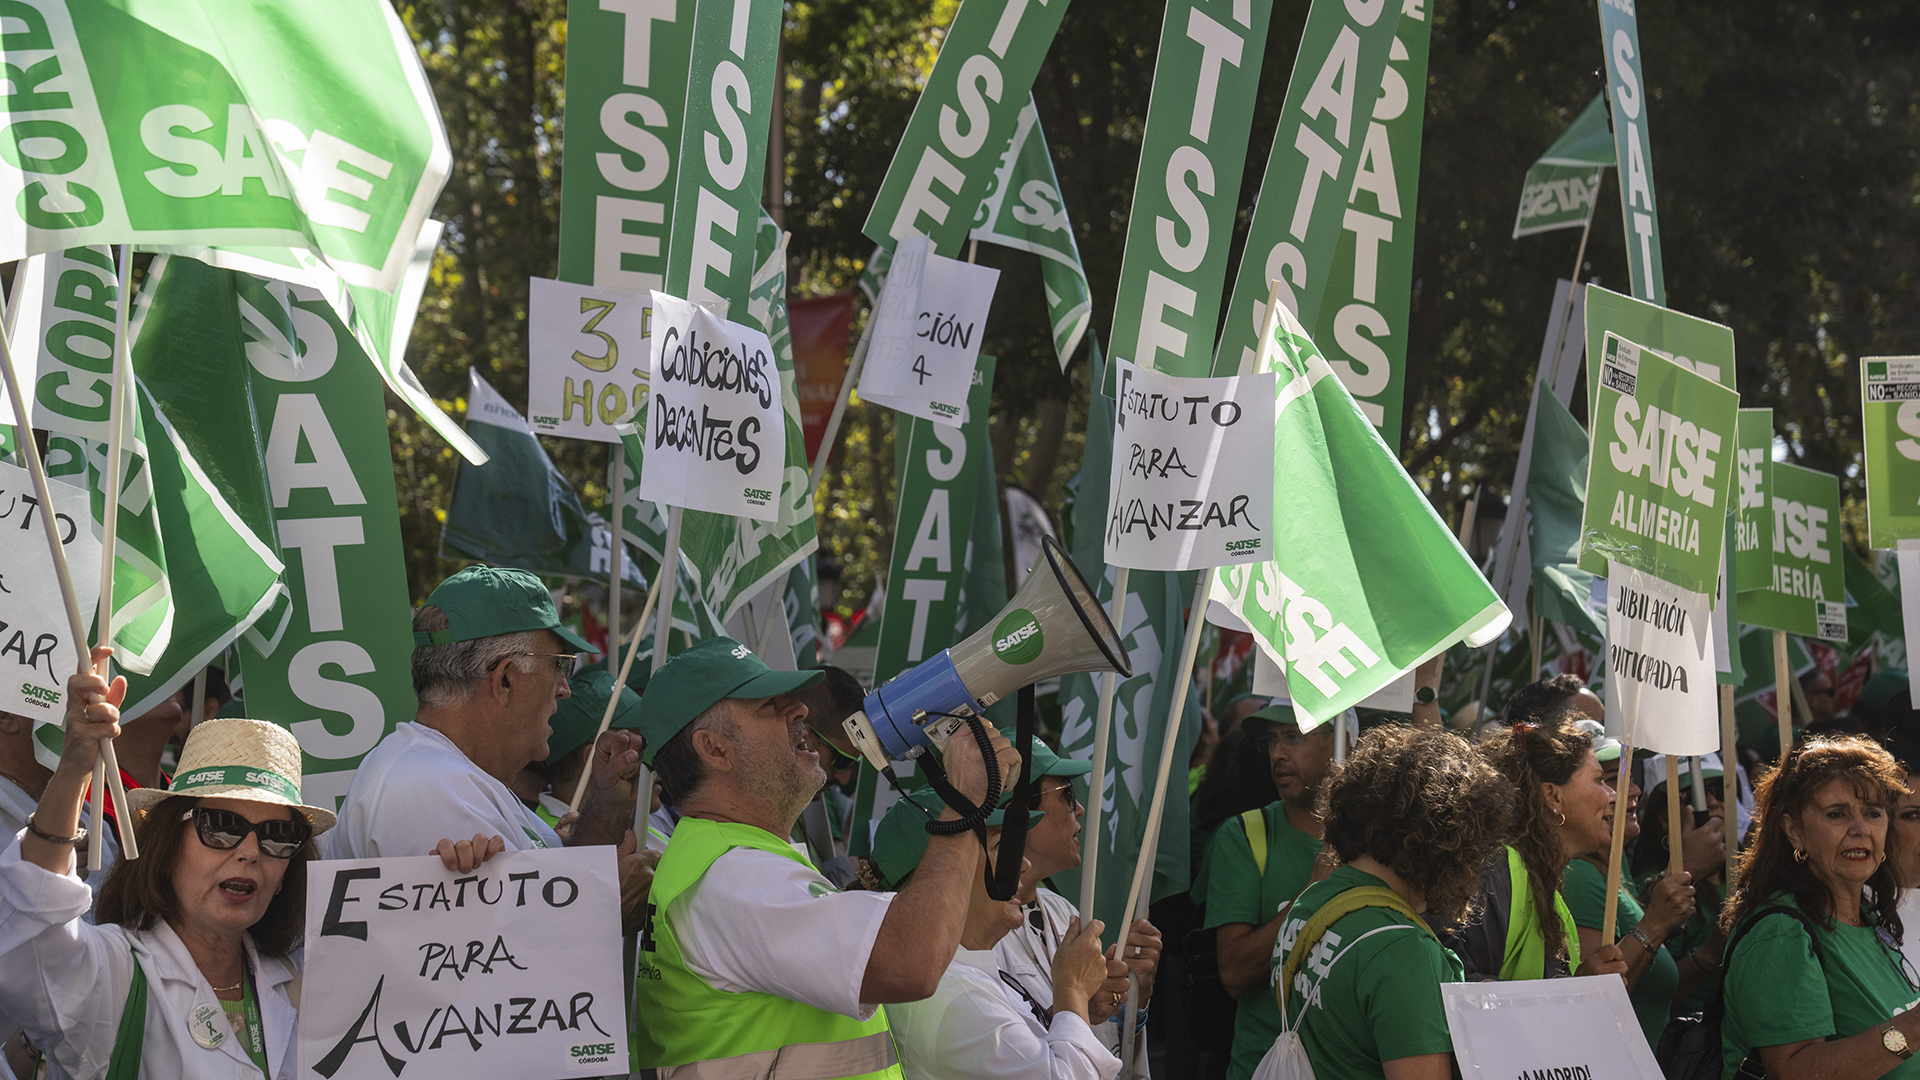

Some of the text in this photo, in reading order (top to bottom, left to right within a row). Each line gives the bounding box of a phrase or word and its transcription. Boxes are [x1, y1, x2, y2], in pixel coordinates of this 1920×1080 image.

[929, 400, 961, 416] SATSE
[1118, 369, 1242, 431] ESTATUTO
[1869, 385, 1885, 400] NO
[533, 415, 560, 426] SATSE
[1129, 443, 1198, 480] PARA
[1609, 394, 1722, 508] SATSE
[743, 488, 772, 501] SATSE
[1107, 463, 1261, 552] AVANZAR
[1610, 489, 1700, 556] ALMERÍA
[1225, 538, 1262, 551] SATSE
[1616, 585, 1687, 637] JUBILACIÓN
[996, 620, 1039, 652] SATSE
[21, 682, 62, 704] SATSE
[186, 770, 226, 785] SATSE
[320, 866, 579, 942] ESTATUTO
[418, 934, 528, 982] PARA
[249, 1023, 262, 1053] SATSE
[311, 974, 611, 1079] AVANZAR
[570, 1043, 616, 1058] SATSE
[578, 1056, 609, 1065] CÓRDOBA
